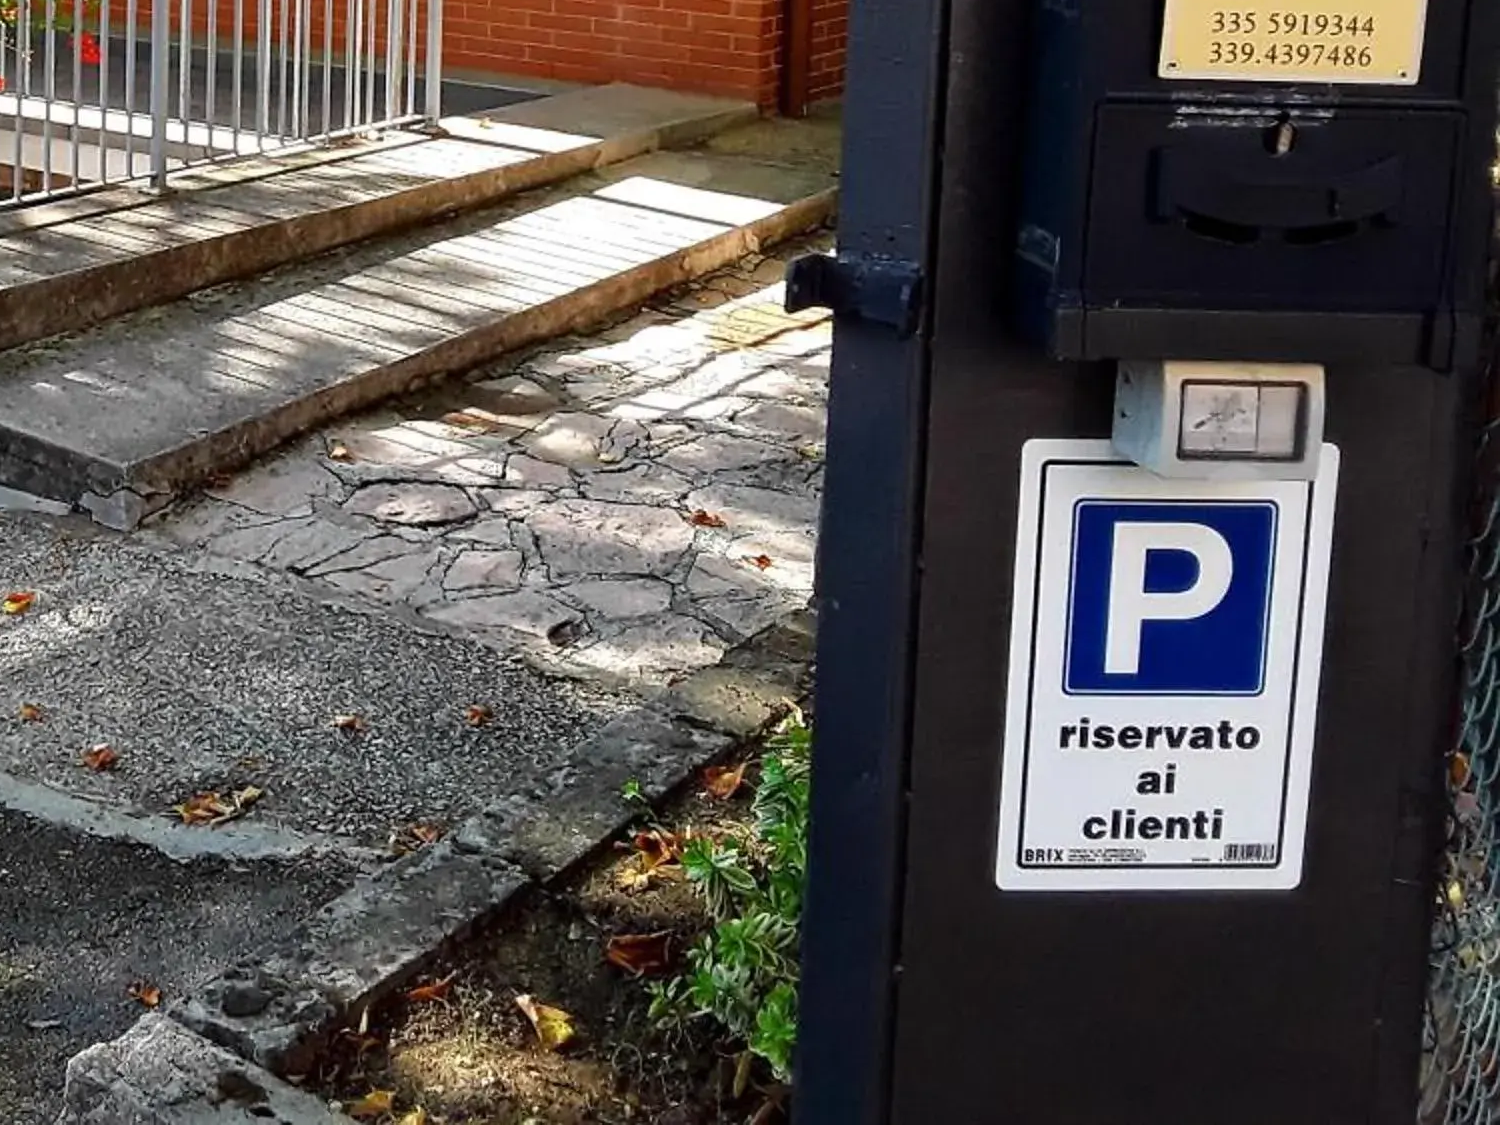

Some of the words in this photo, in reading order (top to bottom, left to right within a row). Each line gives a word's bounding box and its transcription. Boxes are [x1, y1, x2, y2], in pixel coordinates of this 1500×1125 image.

[1210, 11, 1257, 34] 335
[1267, 12, 1375, 38] 5919344
[1208, 41, 1372, 67] 339.4397486
[1104, 521, 1234, 675] P
[1058, 717, 1261, 750] riservato
[1136, 763, 1177, 795] ai
[1082, 809, 1224, 841] clienti
[1024, 848, 1064, 863] BRIX
